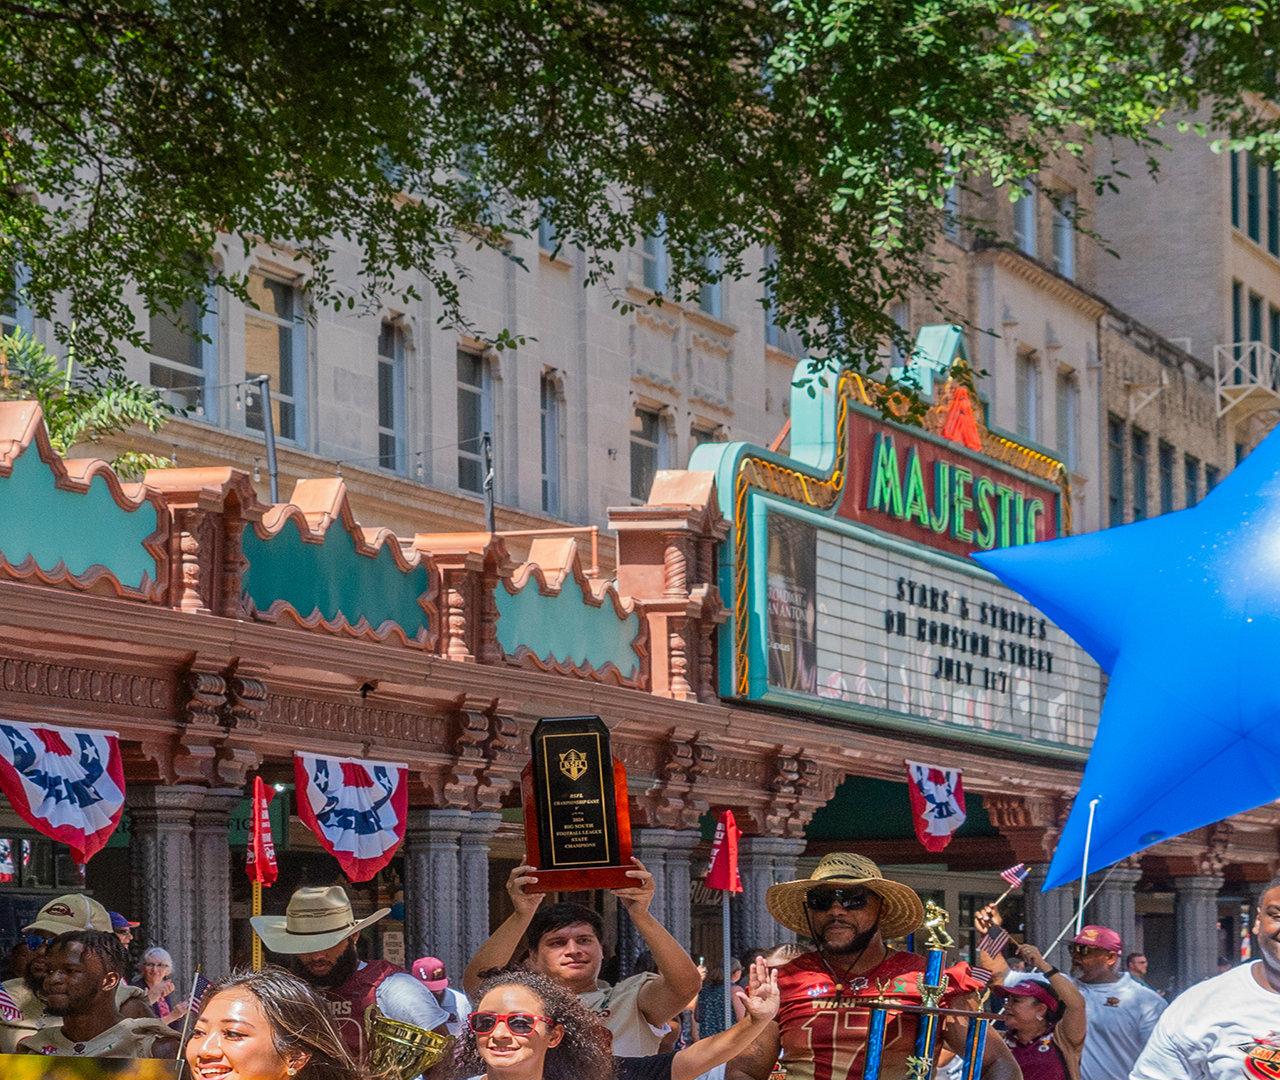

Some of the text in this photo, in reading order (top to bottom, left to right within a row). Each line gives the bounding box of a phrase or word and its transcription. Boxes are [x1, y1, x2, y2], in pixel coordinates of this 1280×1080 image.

[870, 432, 1044, 549] MAJESTIC
[897, 577, 949, 614] STARS
[980, 602, 1046, 640] STRIPES
[885, 609, 1053, 673] ON HOUSTON STREET
[935, 656, 973, 686] JULY
[1250, 1047, 1274, 1060] SAN
